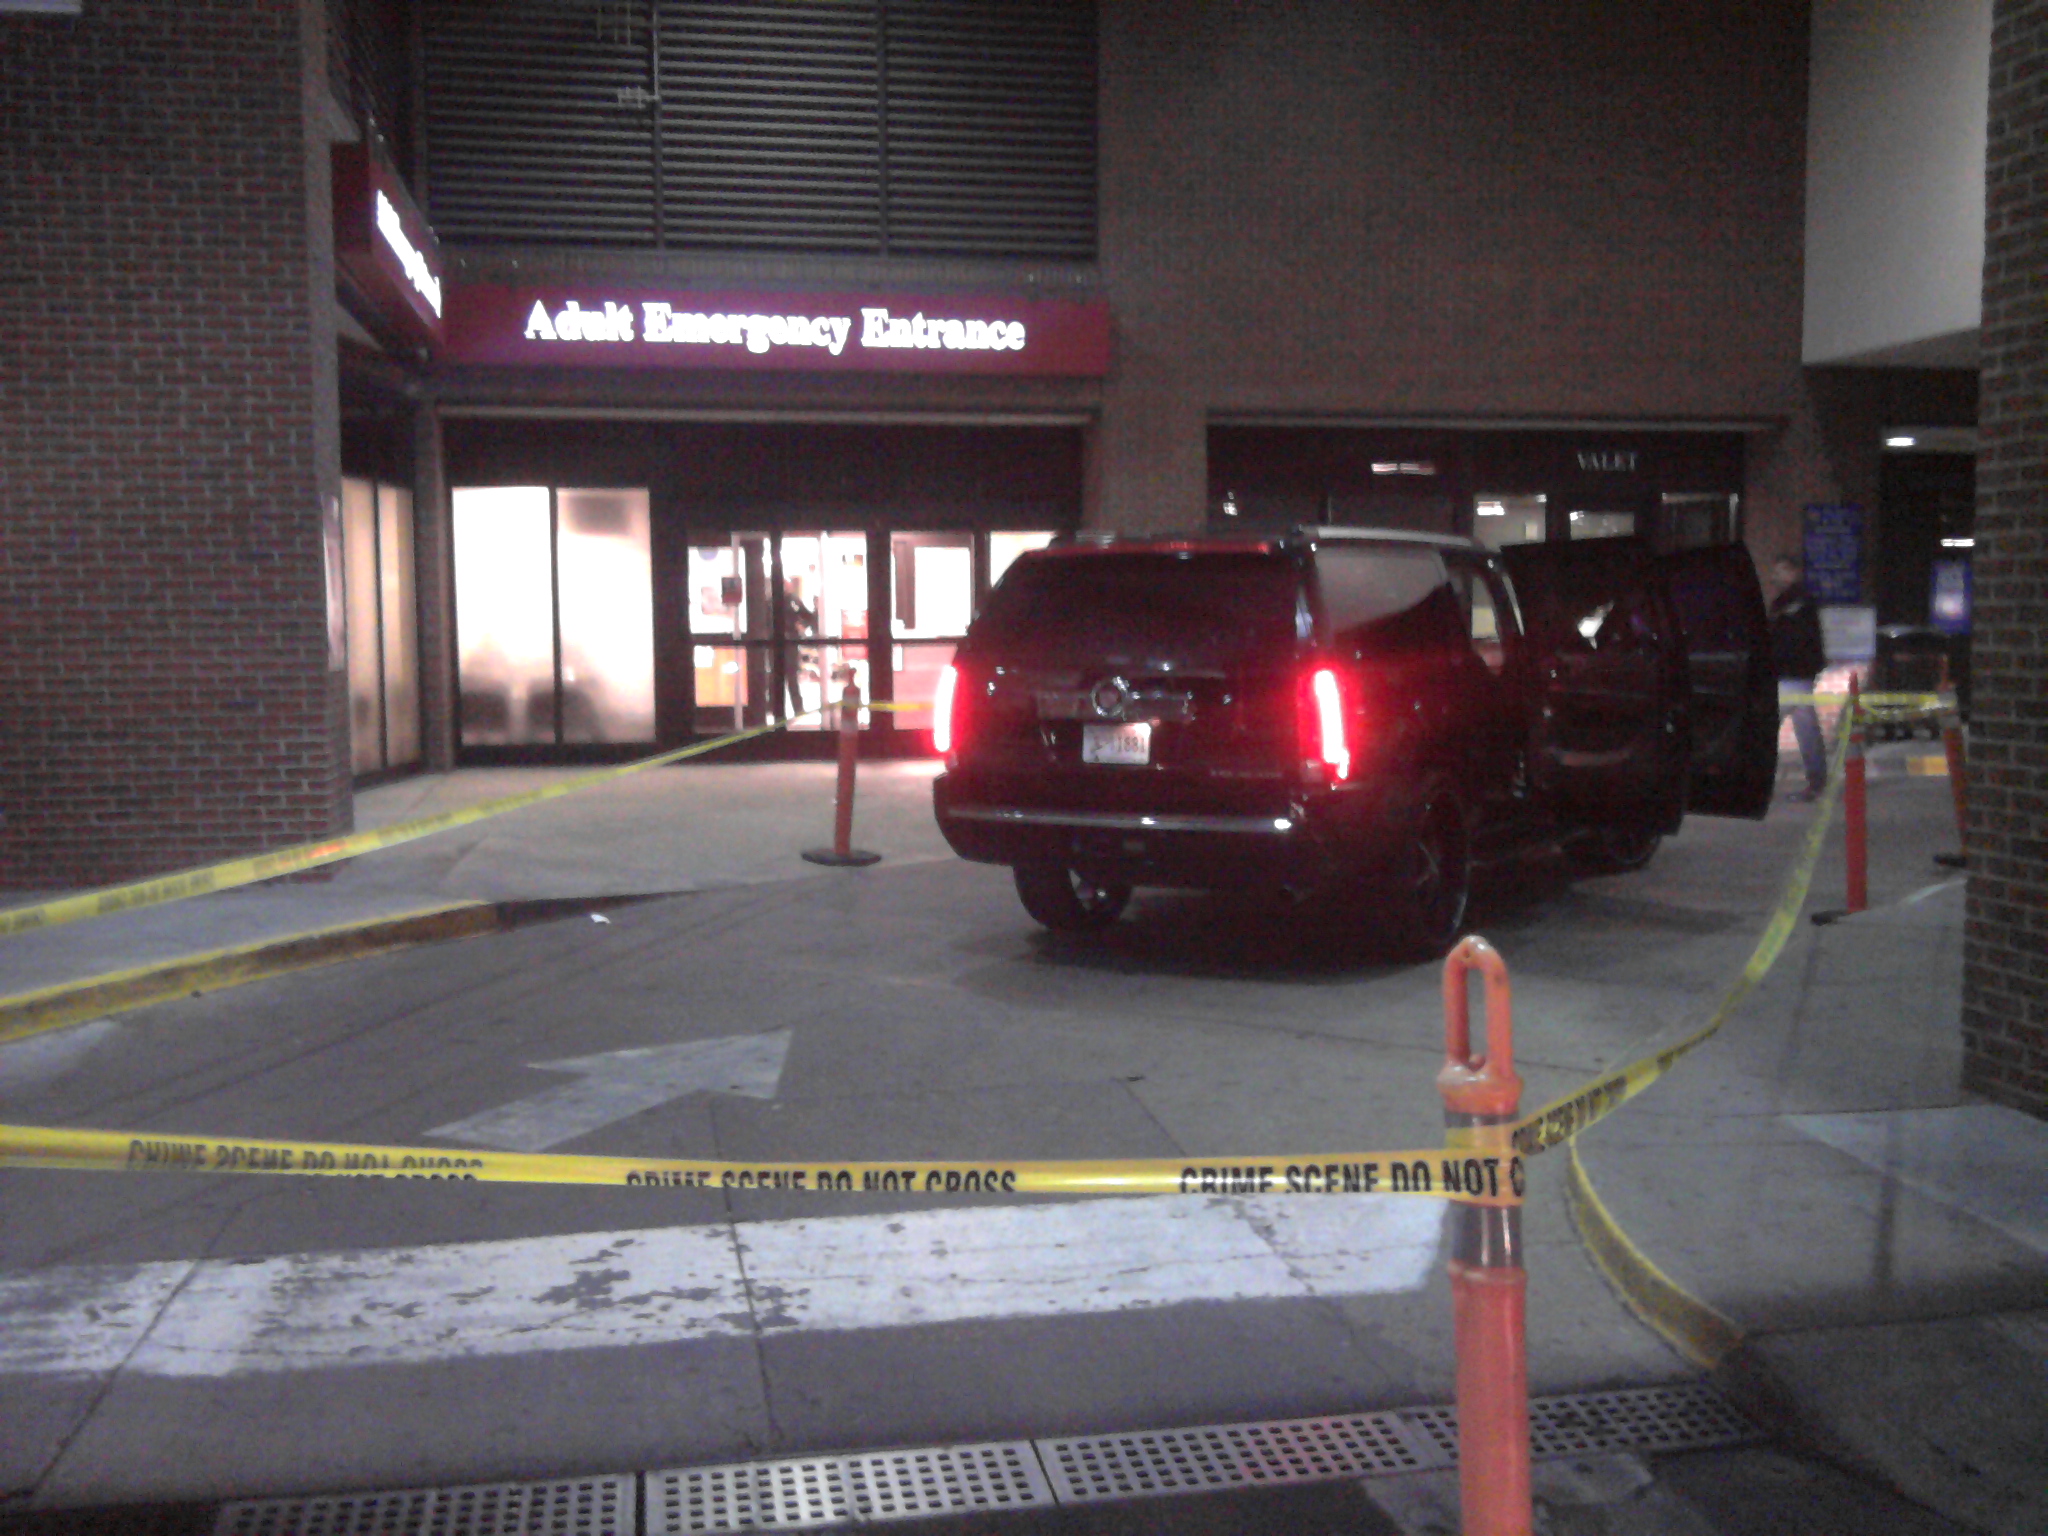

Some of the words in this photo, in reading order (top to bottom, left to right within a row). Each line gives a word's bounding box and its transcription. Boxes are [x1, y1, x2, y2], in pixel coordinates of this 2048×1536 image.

[524, 300, 634, 342] Adult
[642, 302, 851, 356] Emergency
[861, 308, 1026, 350] Entrance
[1179, 1166, 1275, 1194] CRIME
[1285, 1163, 1380, 1194] SCENE
[1390, 1160, 1431, 1193] DO
[1442, 1157, 1499, 1197] NOT
